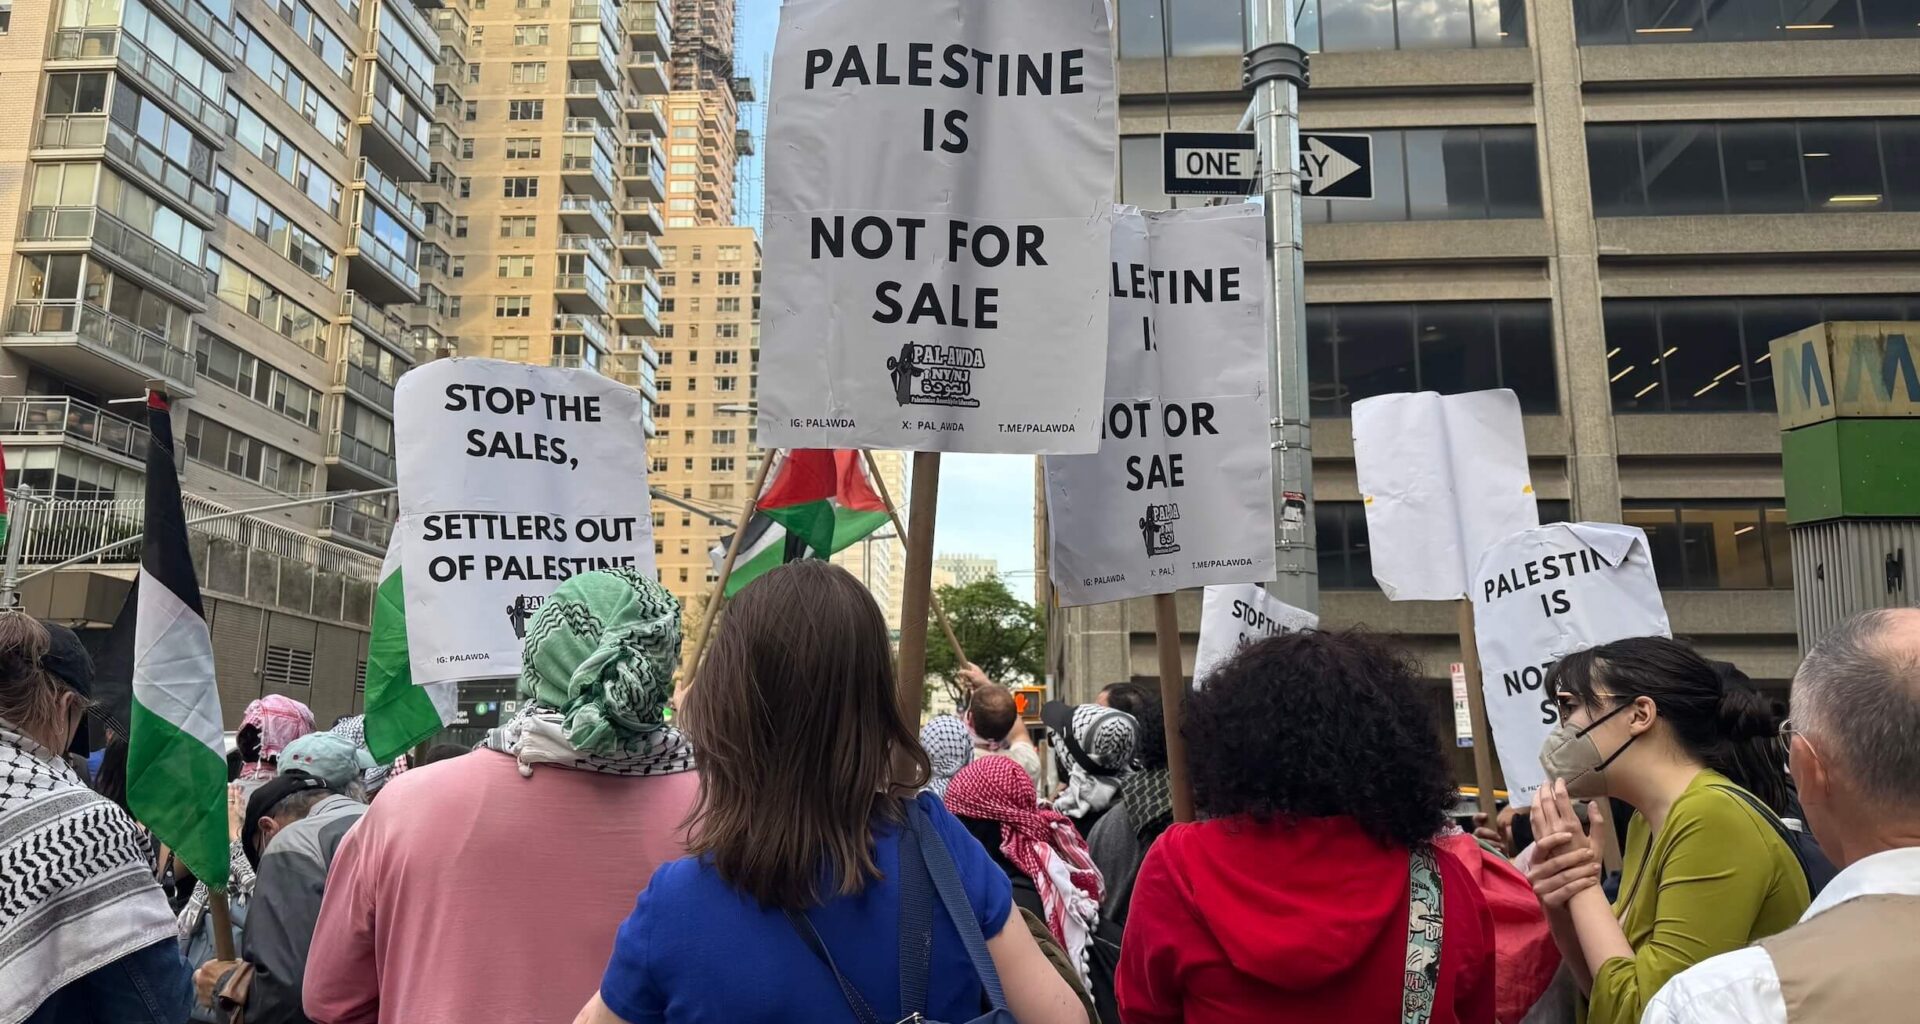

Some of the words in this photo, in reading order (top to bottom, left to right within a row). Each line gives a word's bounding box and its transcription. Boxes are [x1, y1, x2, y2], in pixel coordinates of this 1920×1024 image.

[804, 42, 1084, 97] PALESTINE
[922, 108, 969, 154] IS
[1186, 151, 1241, 176] ONE
[1300, 154, 1330, 177] AY
[810, 215, 926, 261] NOT
[948, 219, 1049, 268] FOR
[1109, 261, 1240, 305] LETINE
[871, 280, 999, 330] SALE
[912, 345, 984, 369] PAL-AWDA
[444, 383, 536, 415] STOP
[541, 392, 602, 422] THE
[790, 418, 803, 428] IG:
[806, 418, 856, 428] PALAWDA
[902, 420, 912, 430] X:
[917, 420, 965, 432] PAL_AWDA
[998, 423, 1076, 433] T.ME/PALAWDA
[1102, 402, 1152, 440] OT
[1161, 402, 1219, 438] OR
[466, 428, 579, 471] SALES,
[1126, 453, 1185, 492] SAE
[422, 513, 568, 543] SETTLERS
[575, 517, 637, 543] OUT
[428, 554, 475, 583] OF
[484, 554, 637, 581] PALESTINE
[1191, 558, 1253, 569] T.ME/PALAWDA
[1484, 547, 1616, 603] PALESTIN
[1094, 573, 1126, 586] PALAWDA
[1231, 599, 1265, 630] STOP
[1540, 589, 1571, 618] IS
[436, 656, 448, 664] IG:
[449, 652, 490, 663] PALAWDA
